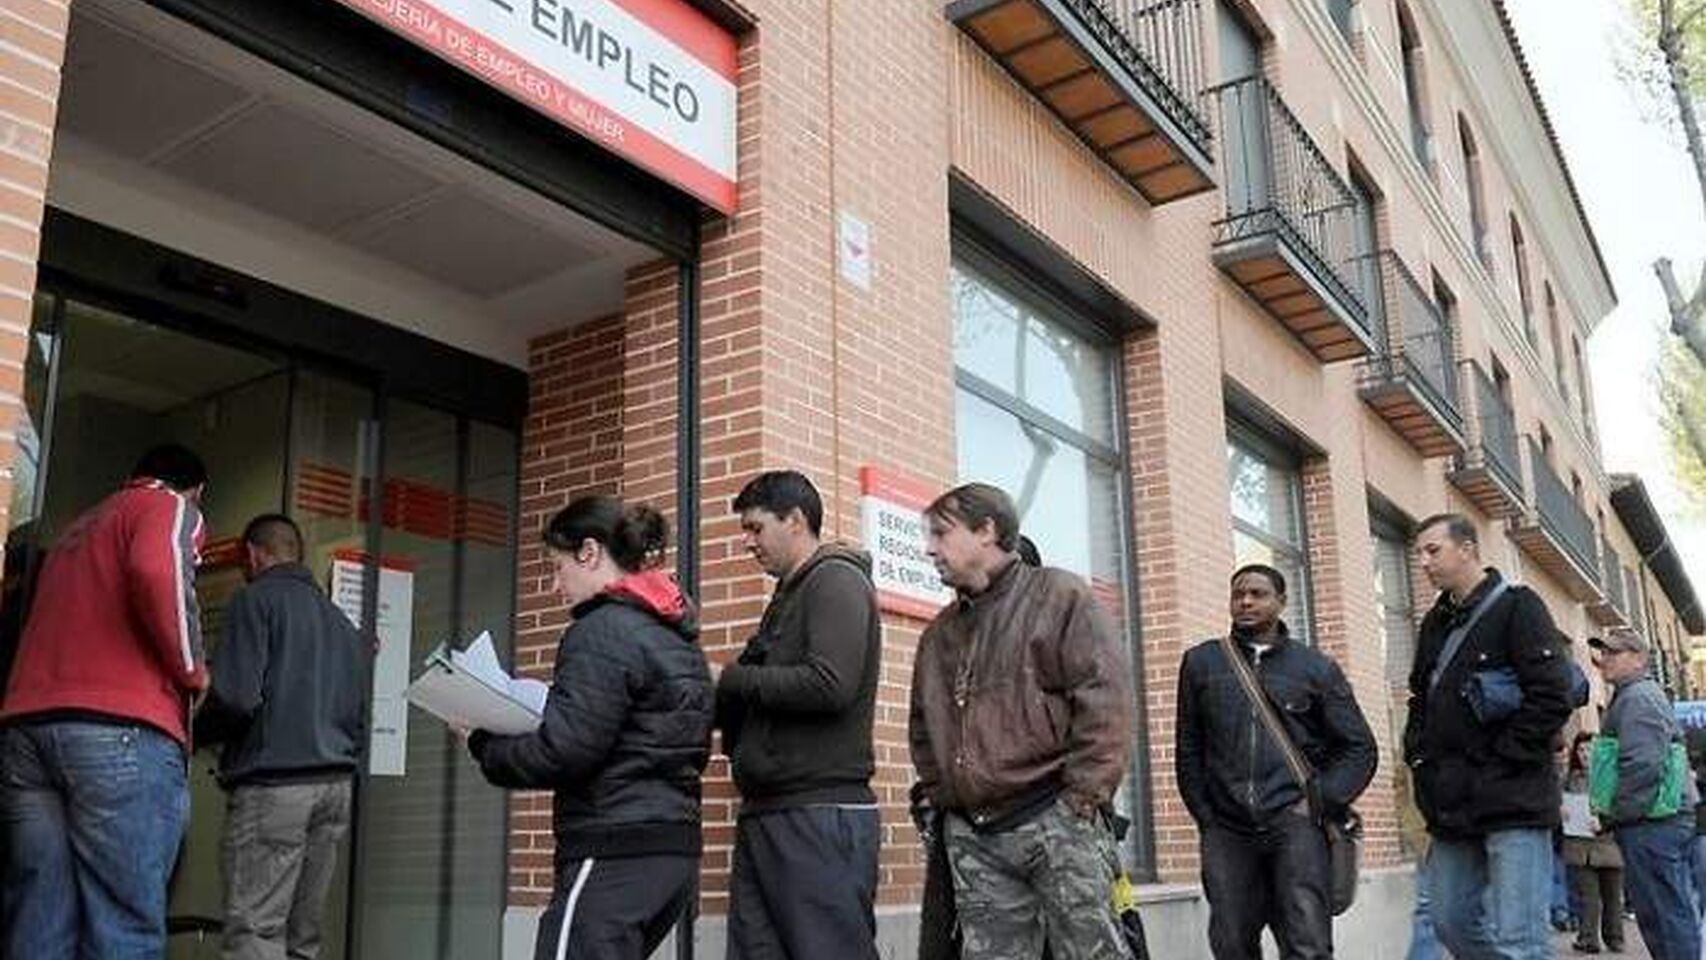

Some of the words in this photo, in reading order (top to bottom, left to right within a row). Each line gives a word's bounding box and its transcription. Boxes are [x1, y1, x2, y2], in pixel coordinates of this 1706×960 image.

[446, 27, 473, 57] DE
[475, 45, 550, 99] EMPLEO
[552, 84, 568, 107] Y
[531, 0, 699, 122] EMPLEO
